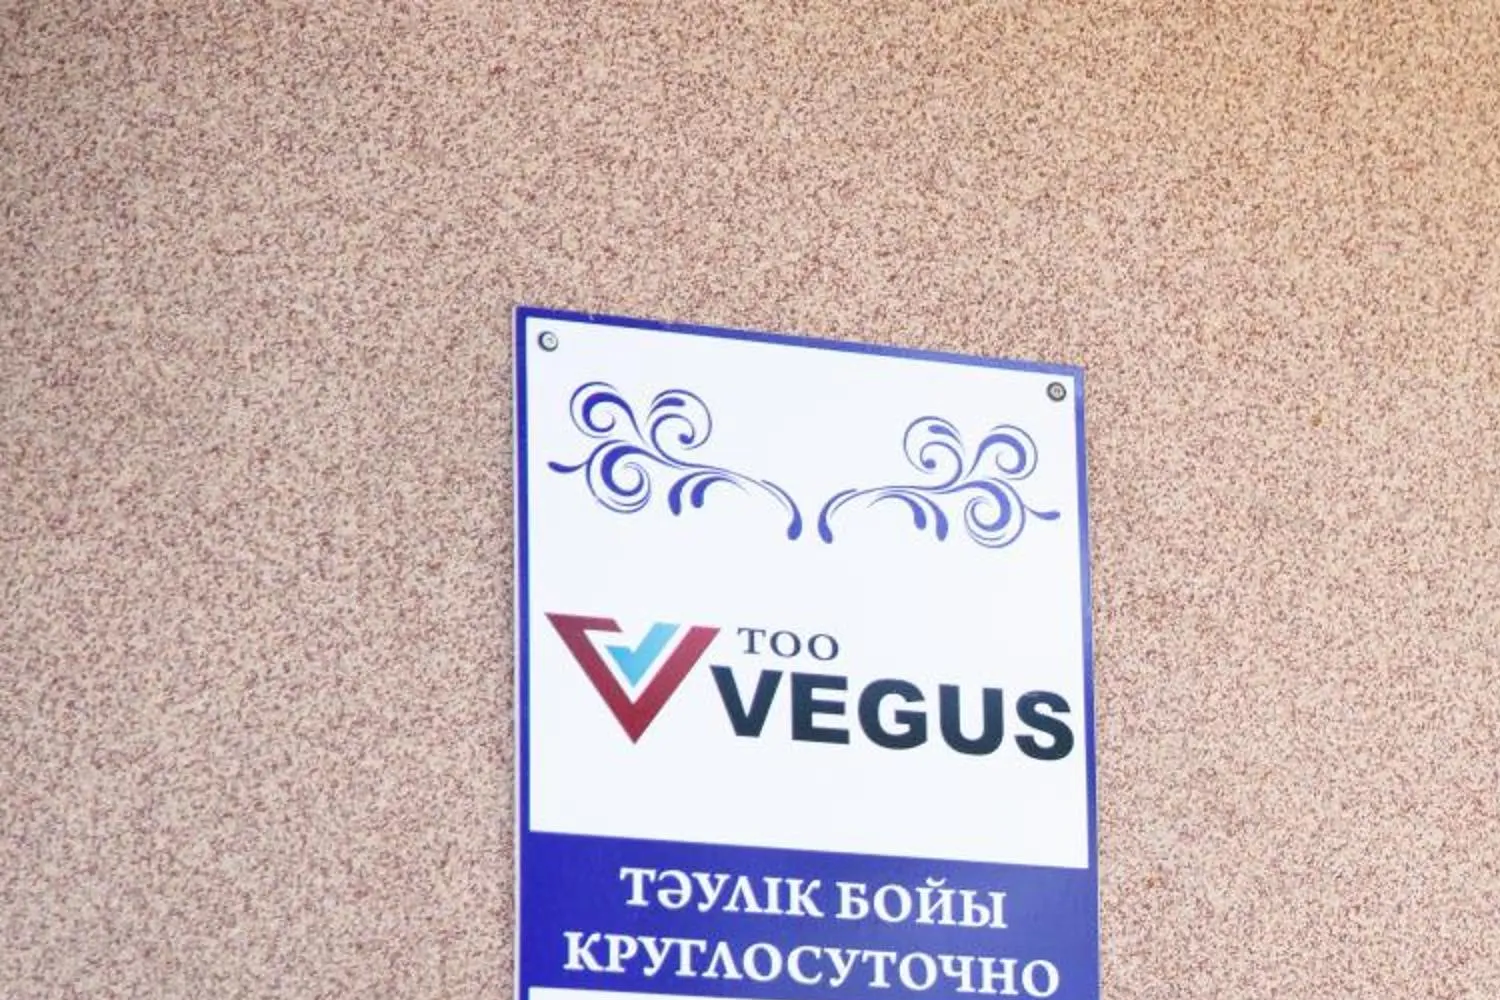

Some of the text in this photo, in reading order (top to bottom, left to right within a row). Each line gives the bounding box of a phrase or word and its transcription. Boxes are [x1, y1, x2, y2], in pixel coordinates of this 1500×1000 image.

[737, 627, 839, 661] ТОО
[709, 664, 1074, 761] VEGUS
[620, 867, 1007, 929] ТӘУЛІК БОЙЫ
[564, 931, 1060, 997] КРУГЛОСУТОЧНО
